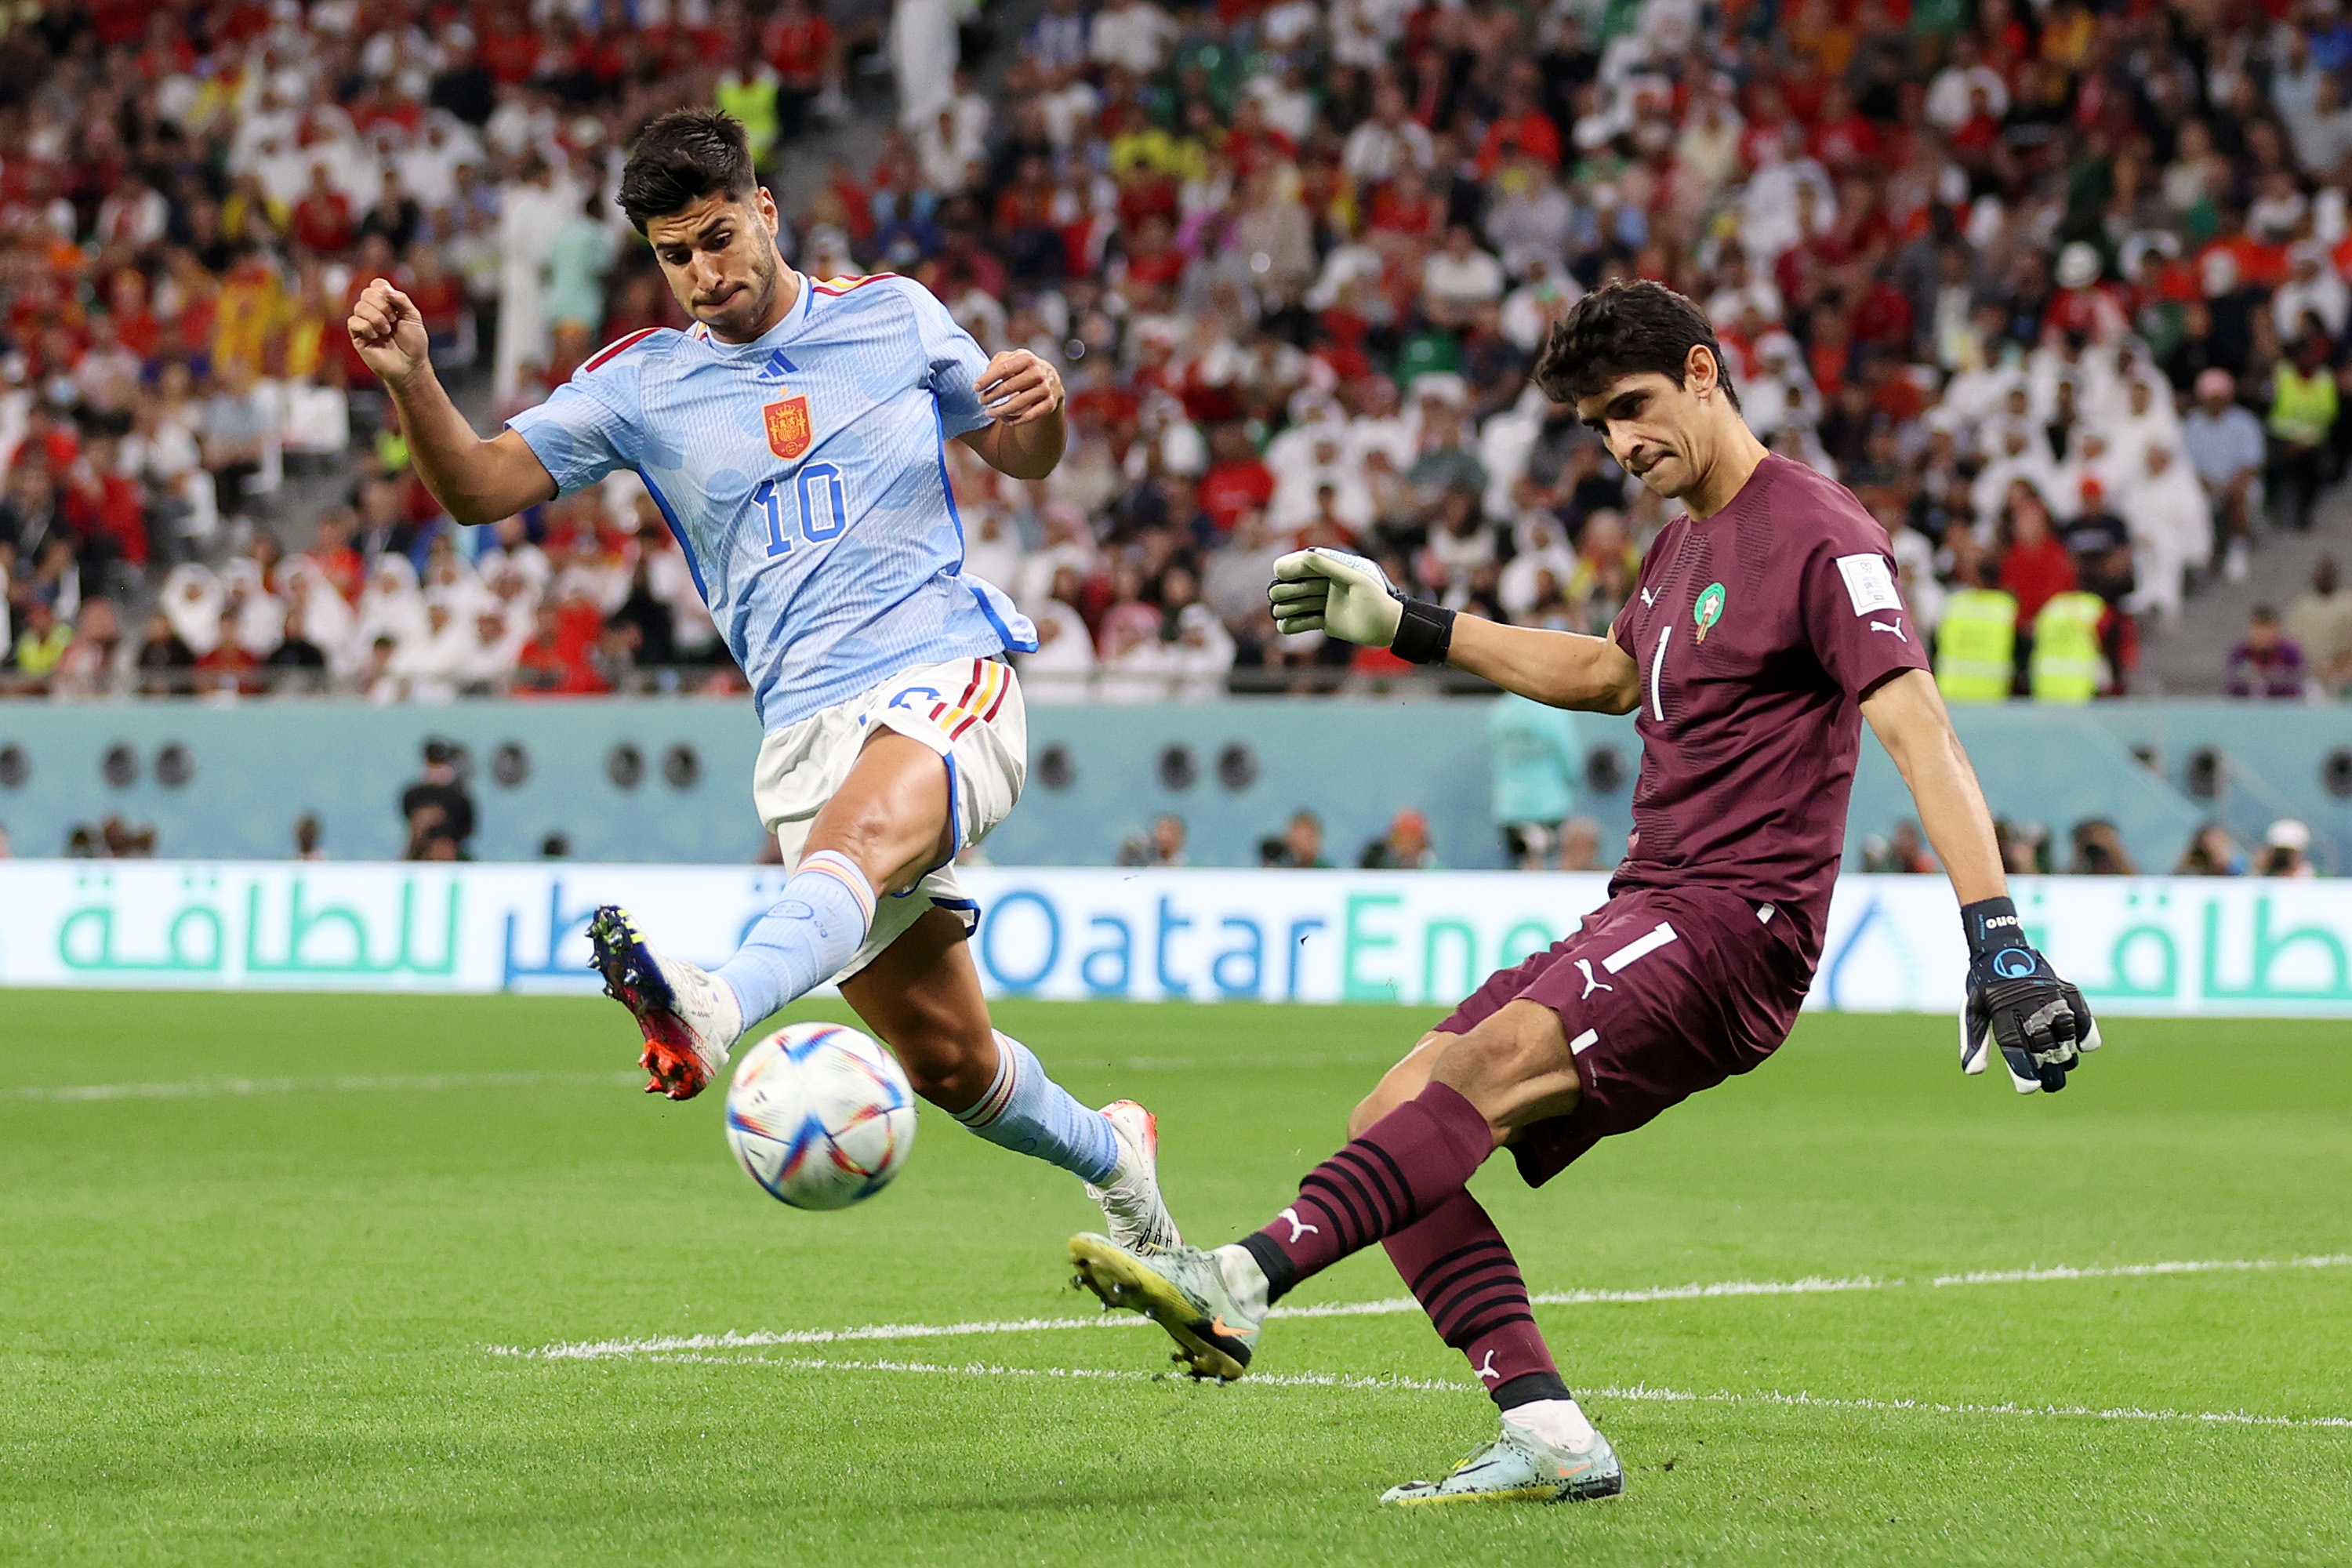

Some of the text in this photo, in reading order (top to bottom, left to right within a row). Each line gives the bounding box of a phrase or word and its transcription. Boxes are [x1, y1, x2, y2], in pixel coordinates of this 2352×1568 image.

[751, 460, 848, 560] 10
[1650, 626, 1672, 721] 1
[56, 873, 461, 975] للطاقة
[982, 889, 1555, 1001] QatarEne
[1601, 920, 1679, 975] 1
